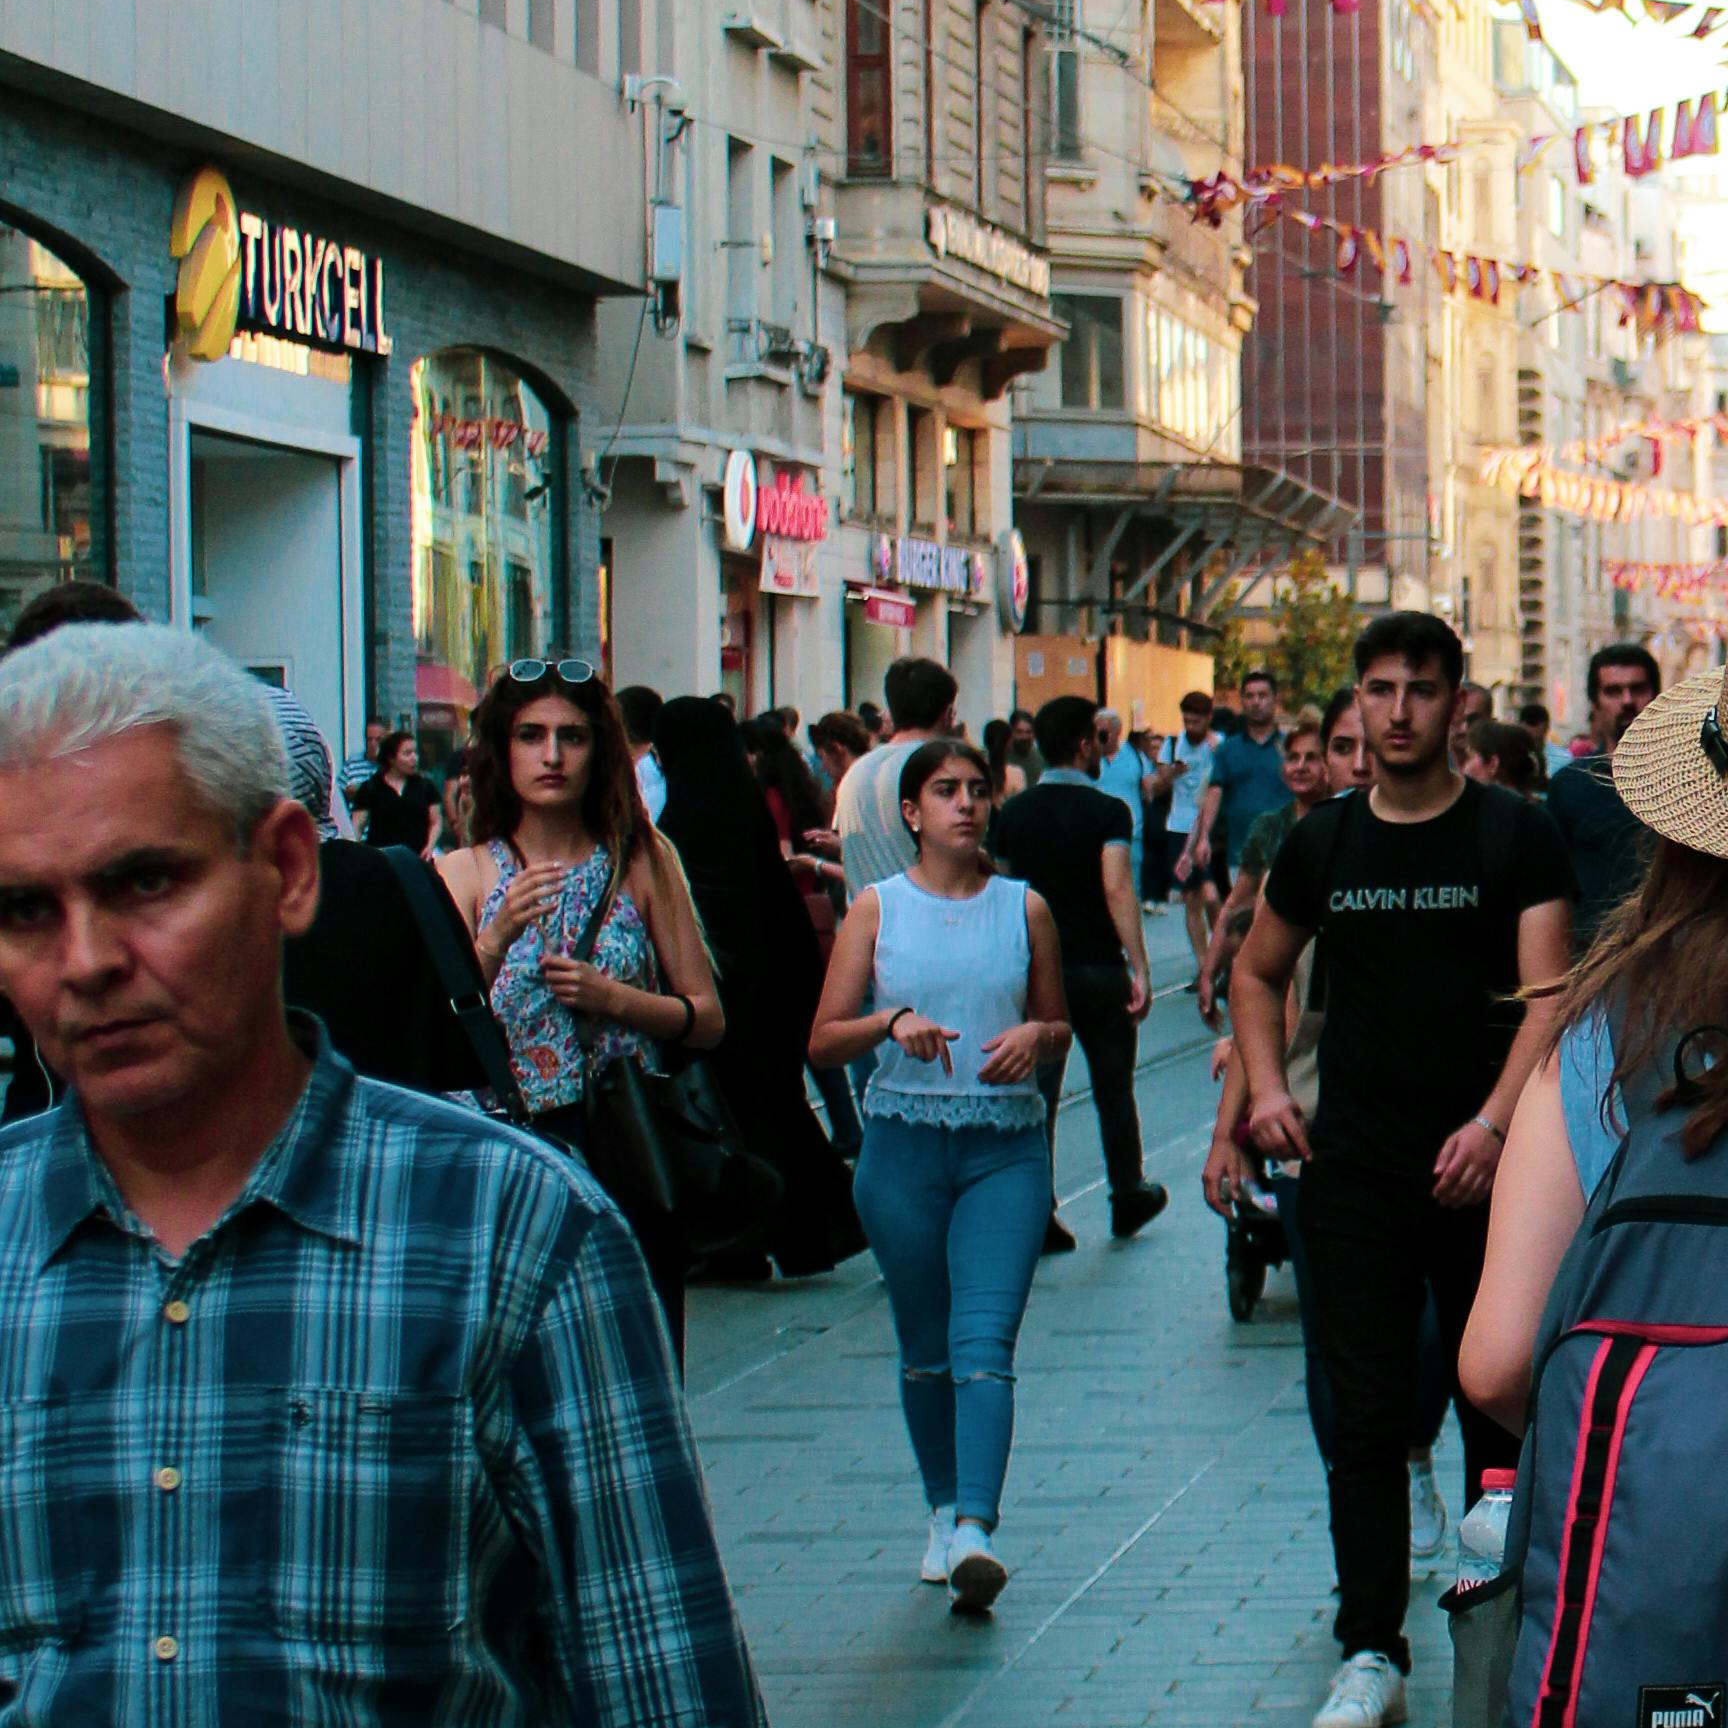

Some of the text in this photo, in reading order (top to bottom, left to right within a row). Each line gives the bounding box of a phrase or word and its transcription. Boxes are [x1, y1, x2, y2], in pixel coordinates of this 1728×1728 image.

[239, 210, 394, 357] TURKCELL
[1329, 886, 1479, 912] CALVIN KLEIN
